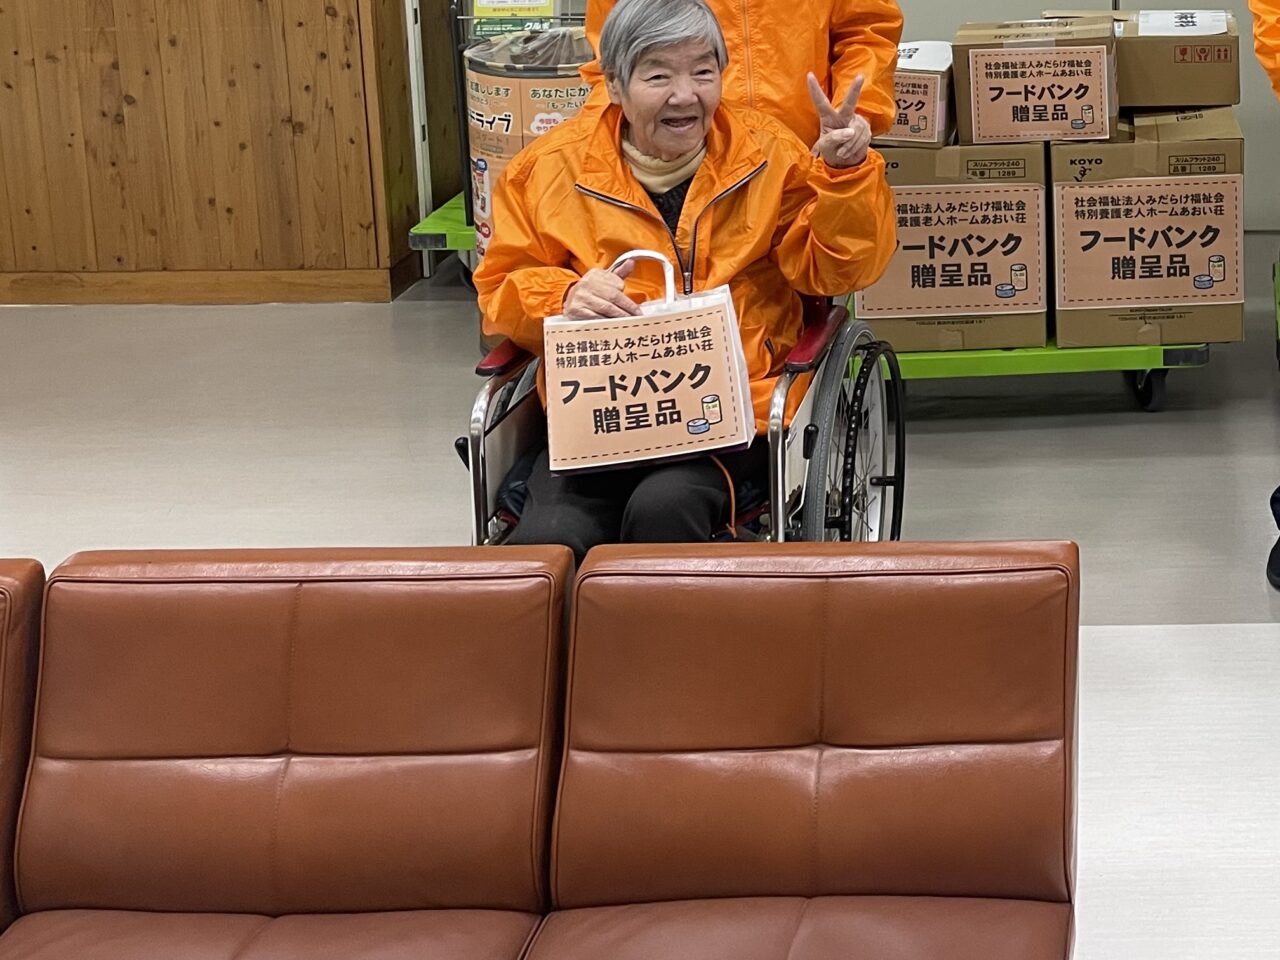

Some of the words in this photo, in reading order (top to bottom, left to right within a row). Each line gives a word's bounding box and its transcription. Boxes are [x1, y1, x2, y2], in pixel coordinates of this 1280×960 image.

[984, 59, 1093, 70] 社会福祉法人みだらけ福祉会
[984, 68, 1093, 80] 特別養護老人ホームあおい荘
[530, 86, 592, 98] あなたにか
[988, 83, 1090, 102] フードバンク
[545, 100, 586, 110] 「もったい
[1011, 104, 1069, 123] 贈呈品
[972, 160, 1021, 168] スリムフラット240
[1069, 158, 1103, 166] KOYO
[1172, 165, 1187, 173] 品番
[1074, 192, 1225, 208] 社会福祉法人みだらけ福祉会
[1074, 205, 1225, 220] 特別養護老人ホームあおい荘
[897, 232, 1023, 260] ードバンク
[1079, 225, 1221, 253] フードバンク
[911, 262, 992, 289] 贈呈品
[1111, 254, 1190, 281] 贈呈品
[555, 325, 713, 355] 社会福祉法人みだらけ福祉会
[555, 339, 714, 369] 特別養護老人ホームあおい荘
[560, 363, 712, 405] フードバンク
[593, 398, 682, 435] 贈呈品
